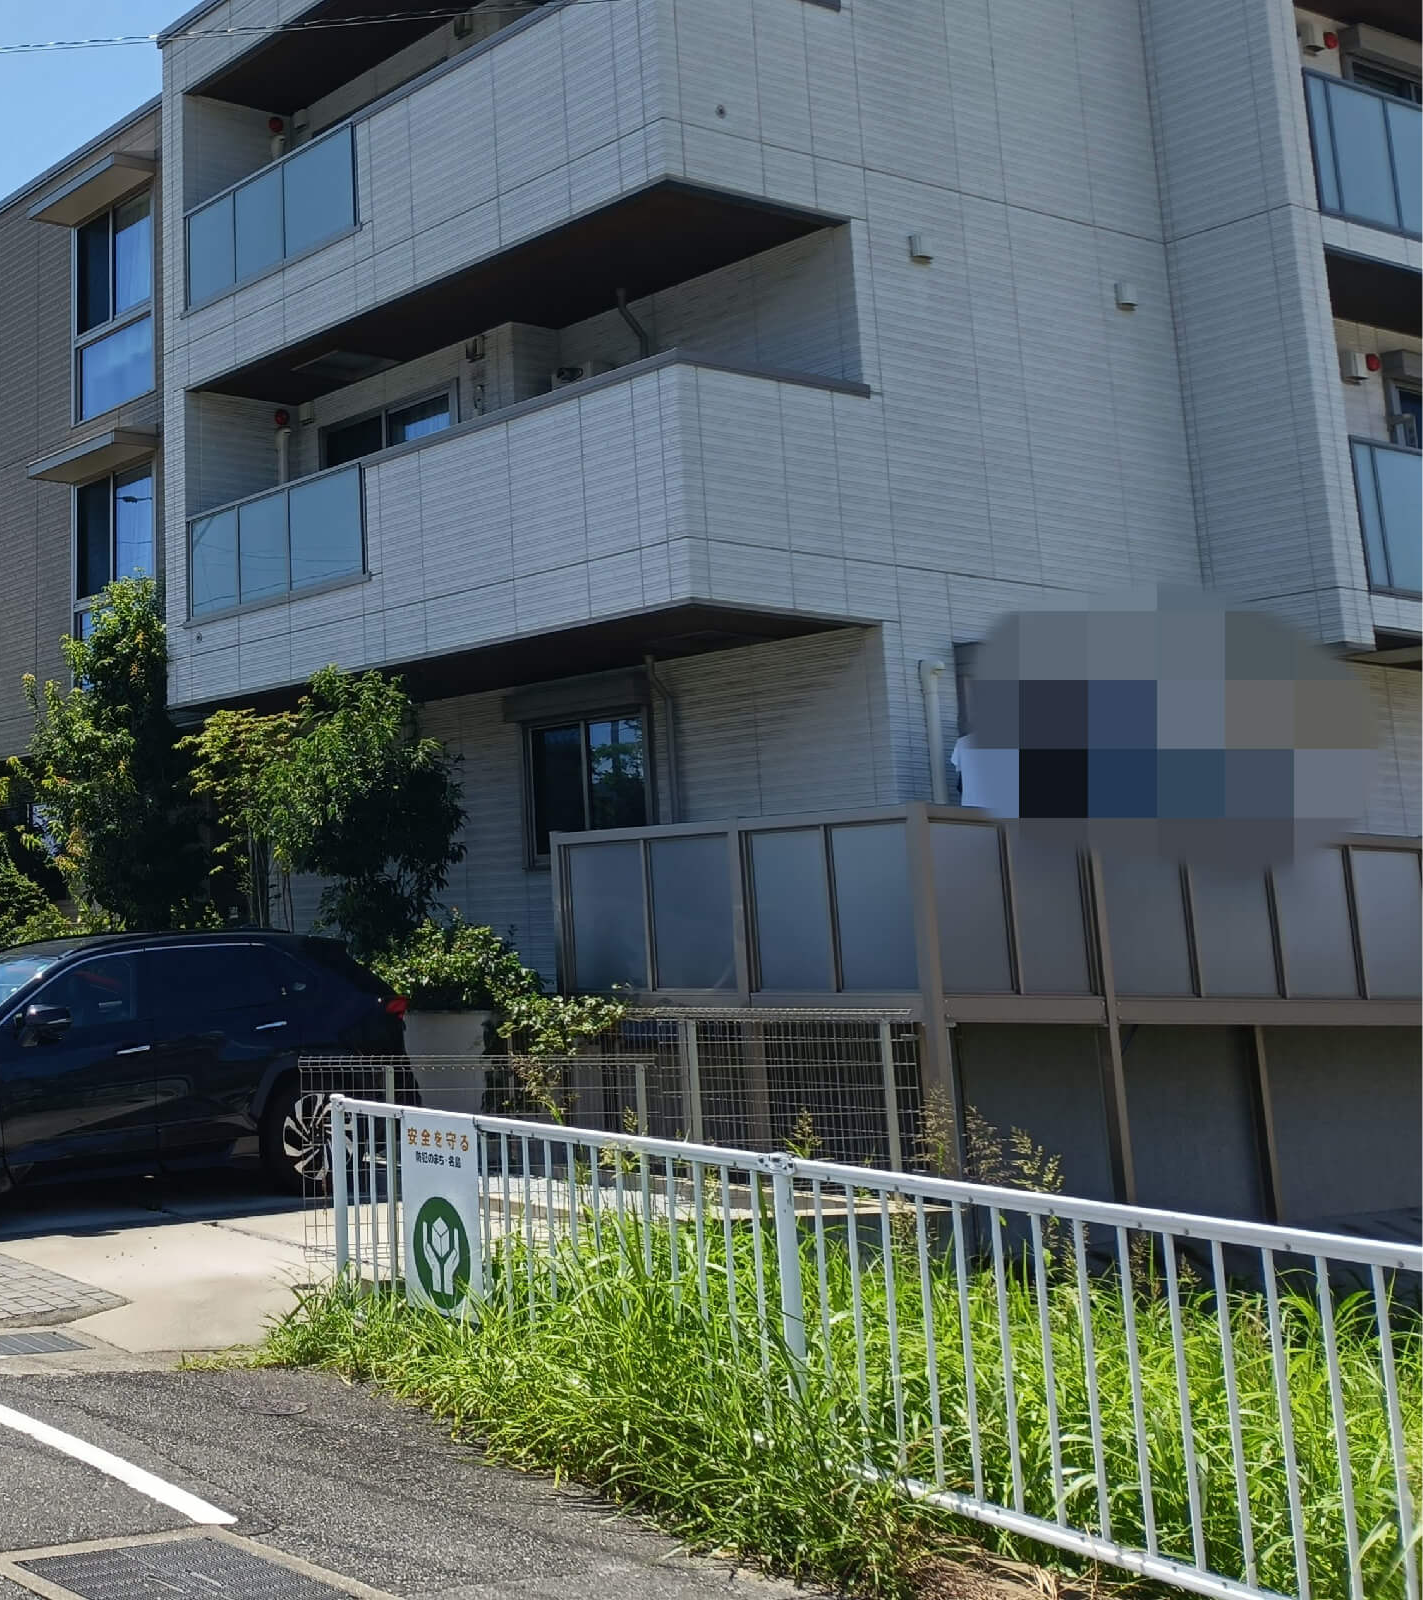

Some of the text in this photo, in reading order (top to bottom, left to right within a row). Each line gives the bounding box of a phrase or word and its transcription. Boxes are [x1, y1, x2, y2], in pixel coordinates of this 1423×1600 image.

[407, 1126, 469, 1152] 安全を守る
